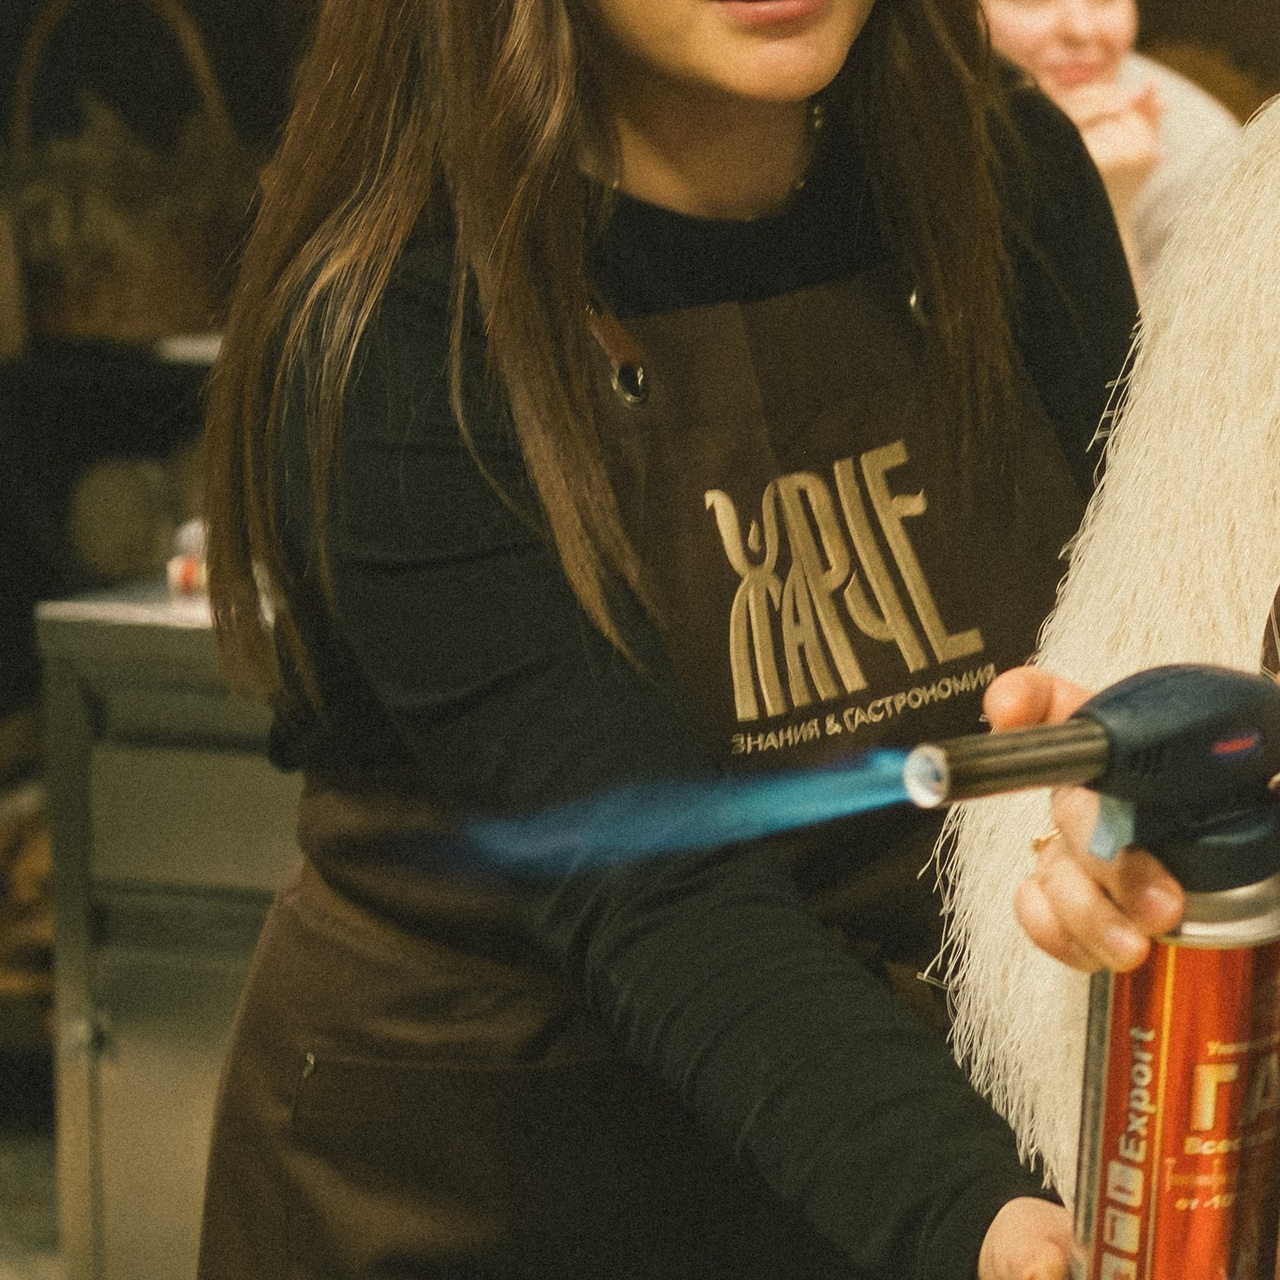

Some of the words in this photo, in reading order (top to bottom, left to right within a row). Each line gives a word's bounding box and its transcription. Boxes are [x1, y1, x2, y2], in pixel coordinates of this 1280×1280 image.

[731, 718, 821, 755] ЗНАНИЯ
[825, 713, 843, 736] &
[843, 662, 997, 733] ГАСТРОНОМИЯ
[1118, 1025, 1157, 1163] Export
